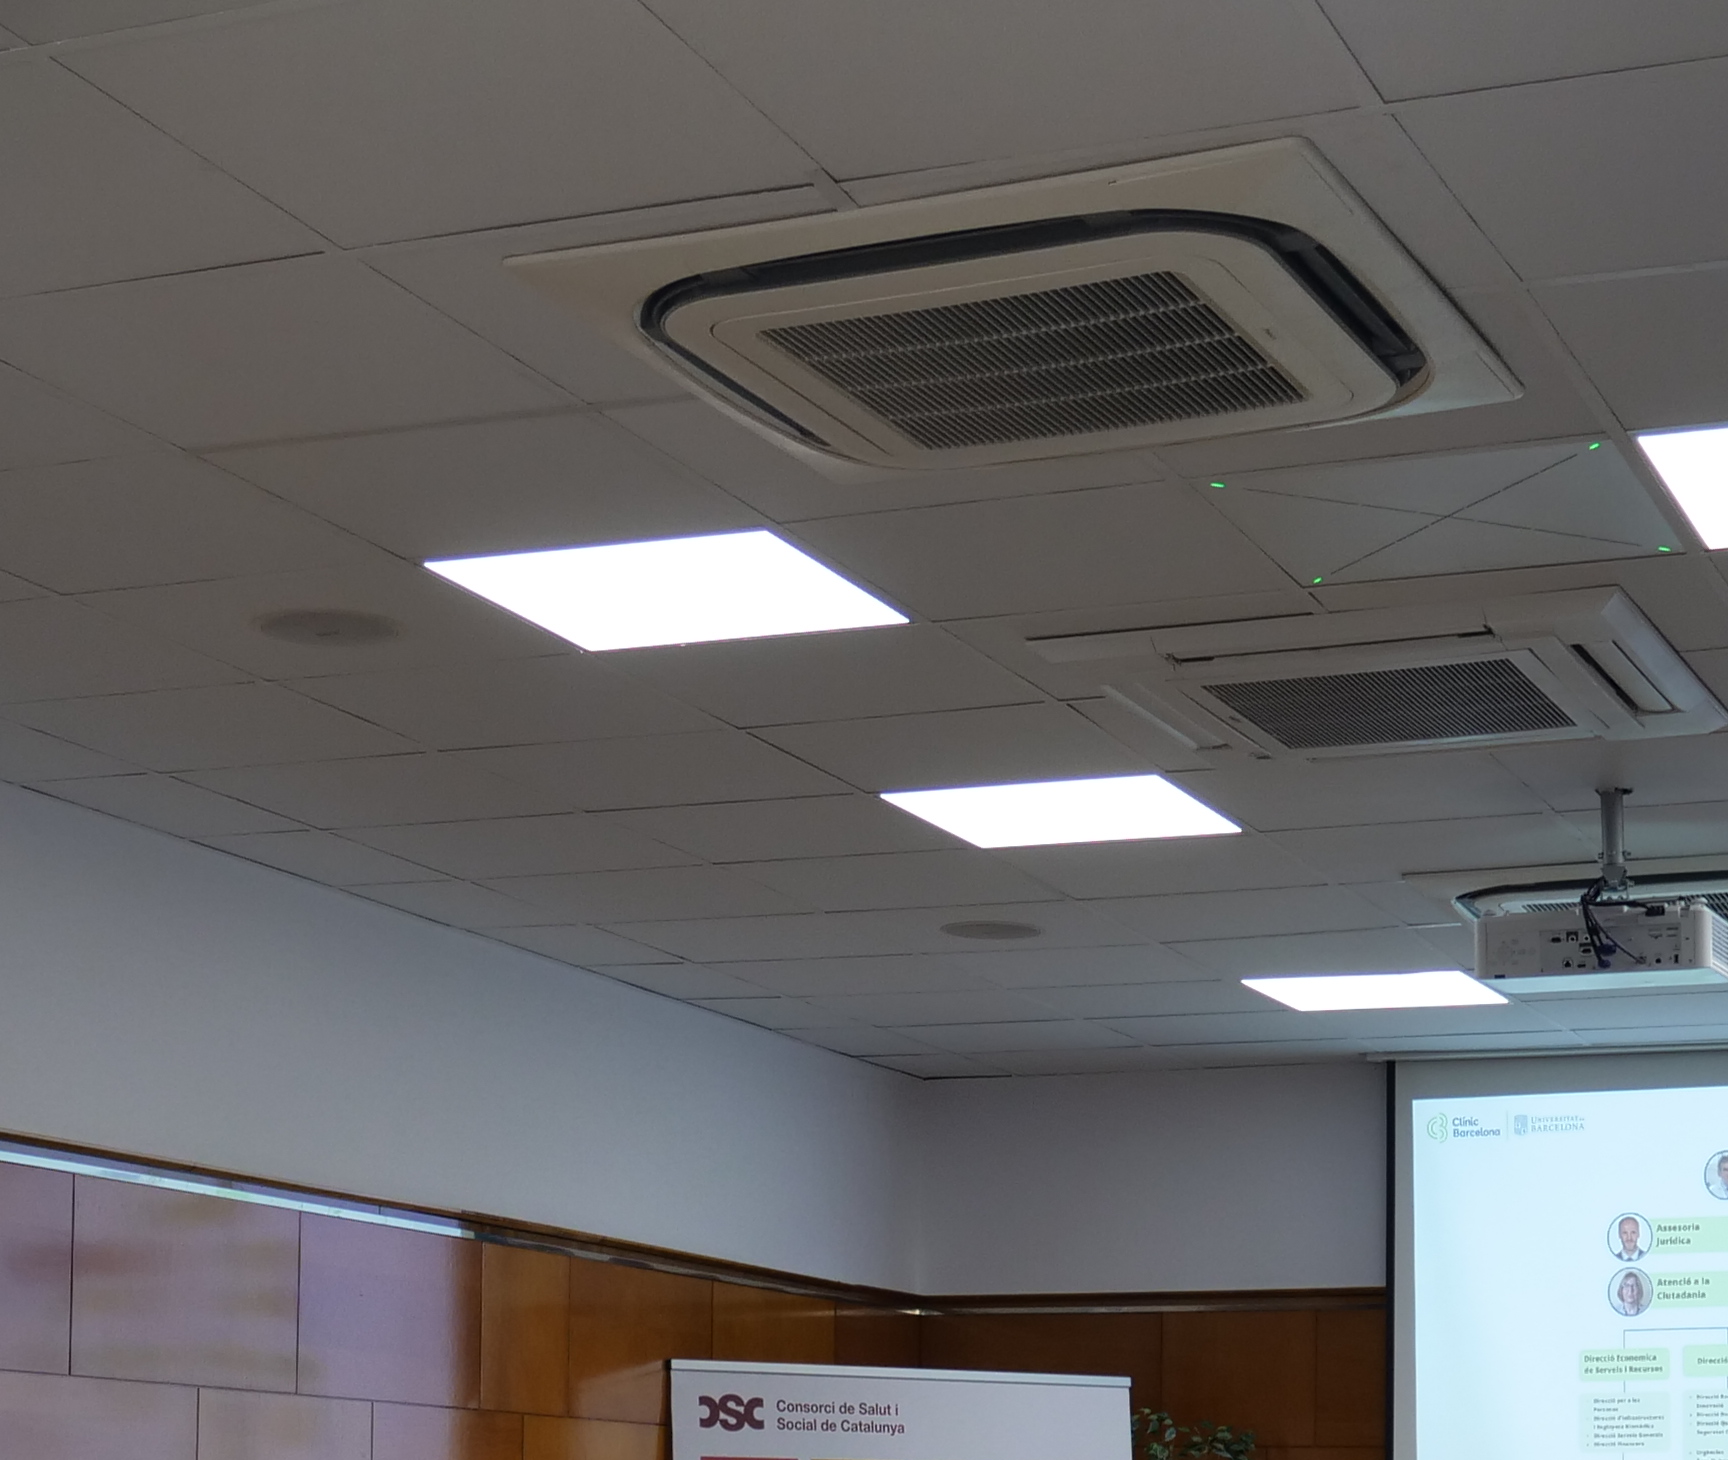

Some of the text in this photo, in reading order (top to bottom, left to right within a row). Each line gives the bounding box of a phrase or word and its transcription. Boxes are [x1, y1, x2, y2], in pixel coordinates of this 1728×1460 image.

[1452, 1117, 1479, 1127] Clínic
[1531, 1123, 1585, 1132] BARCELONA
[1453, 1128, 1501, 1138] Barcelona
[1656, 1236, 1691, 1247] Jurídica
[1657, 1277, 1691, 1287] Atenció
[1584, 1366, 1594, 1374] de
[1596, 1366, 1623, 1374] Serveis
[776, 1400, 899, 1416] Consorci de Salut i
[777, 1417, 905, 1436] Social de Catalunya
